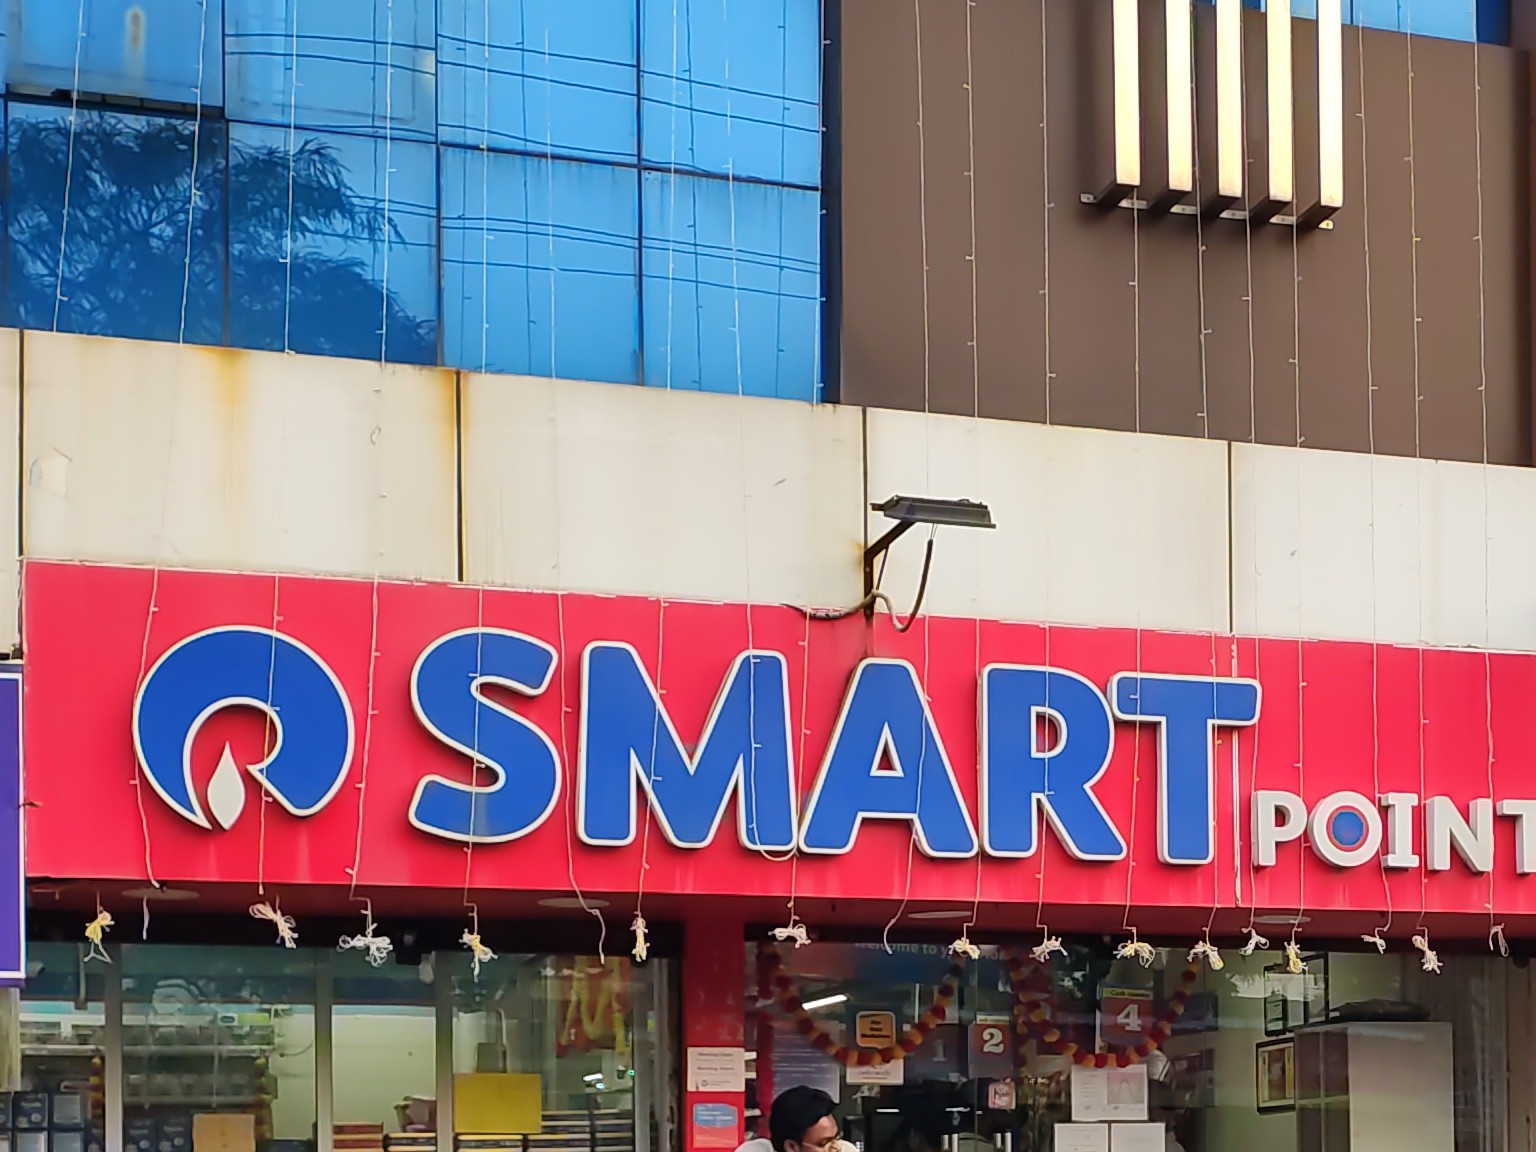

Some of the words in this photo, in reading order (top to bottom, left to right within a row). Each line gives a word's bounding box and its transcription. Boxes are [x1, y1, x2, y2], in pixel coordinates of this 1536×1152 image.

[408, 625, 1263, 866] SMART
[1116, 1003, 1142, 1032] 4
[982, 1027, 1005, 1054] 2
